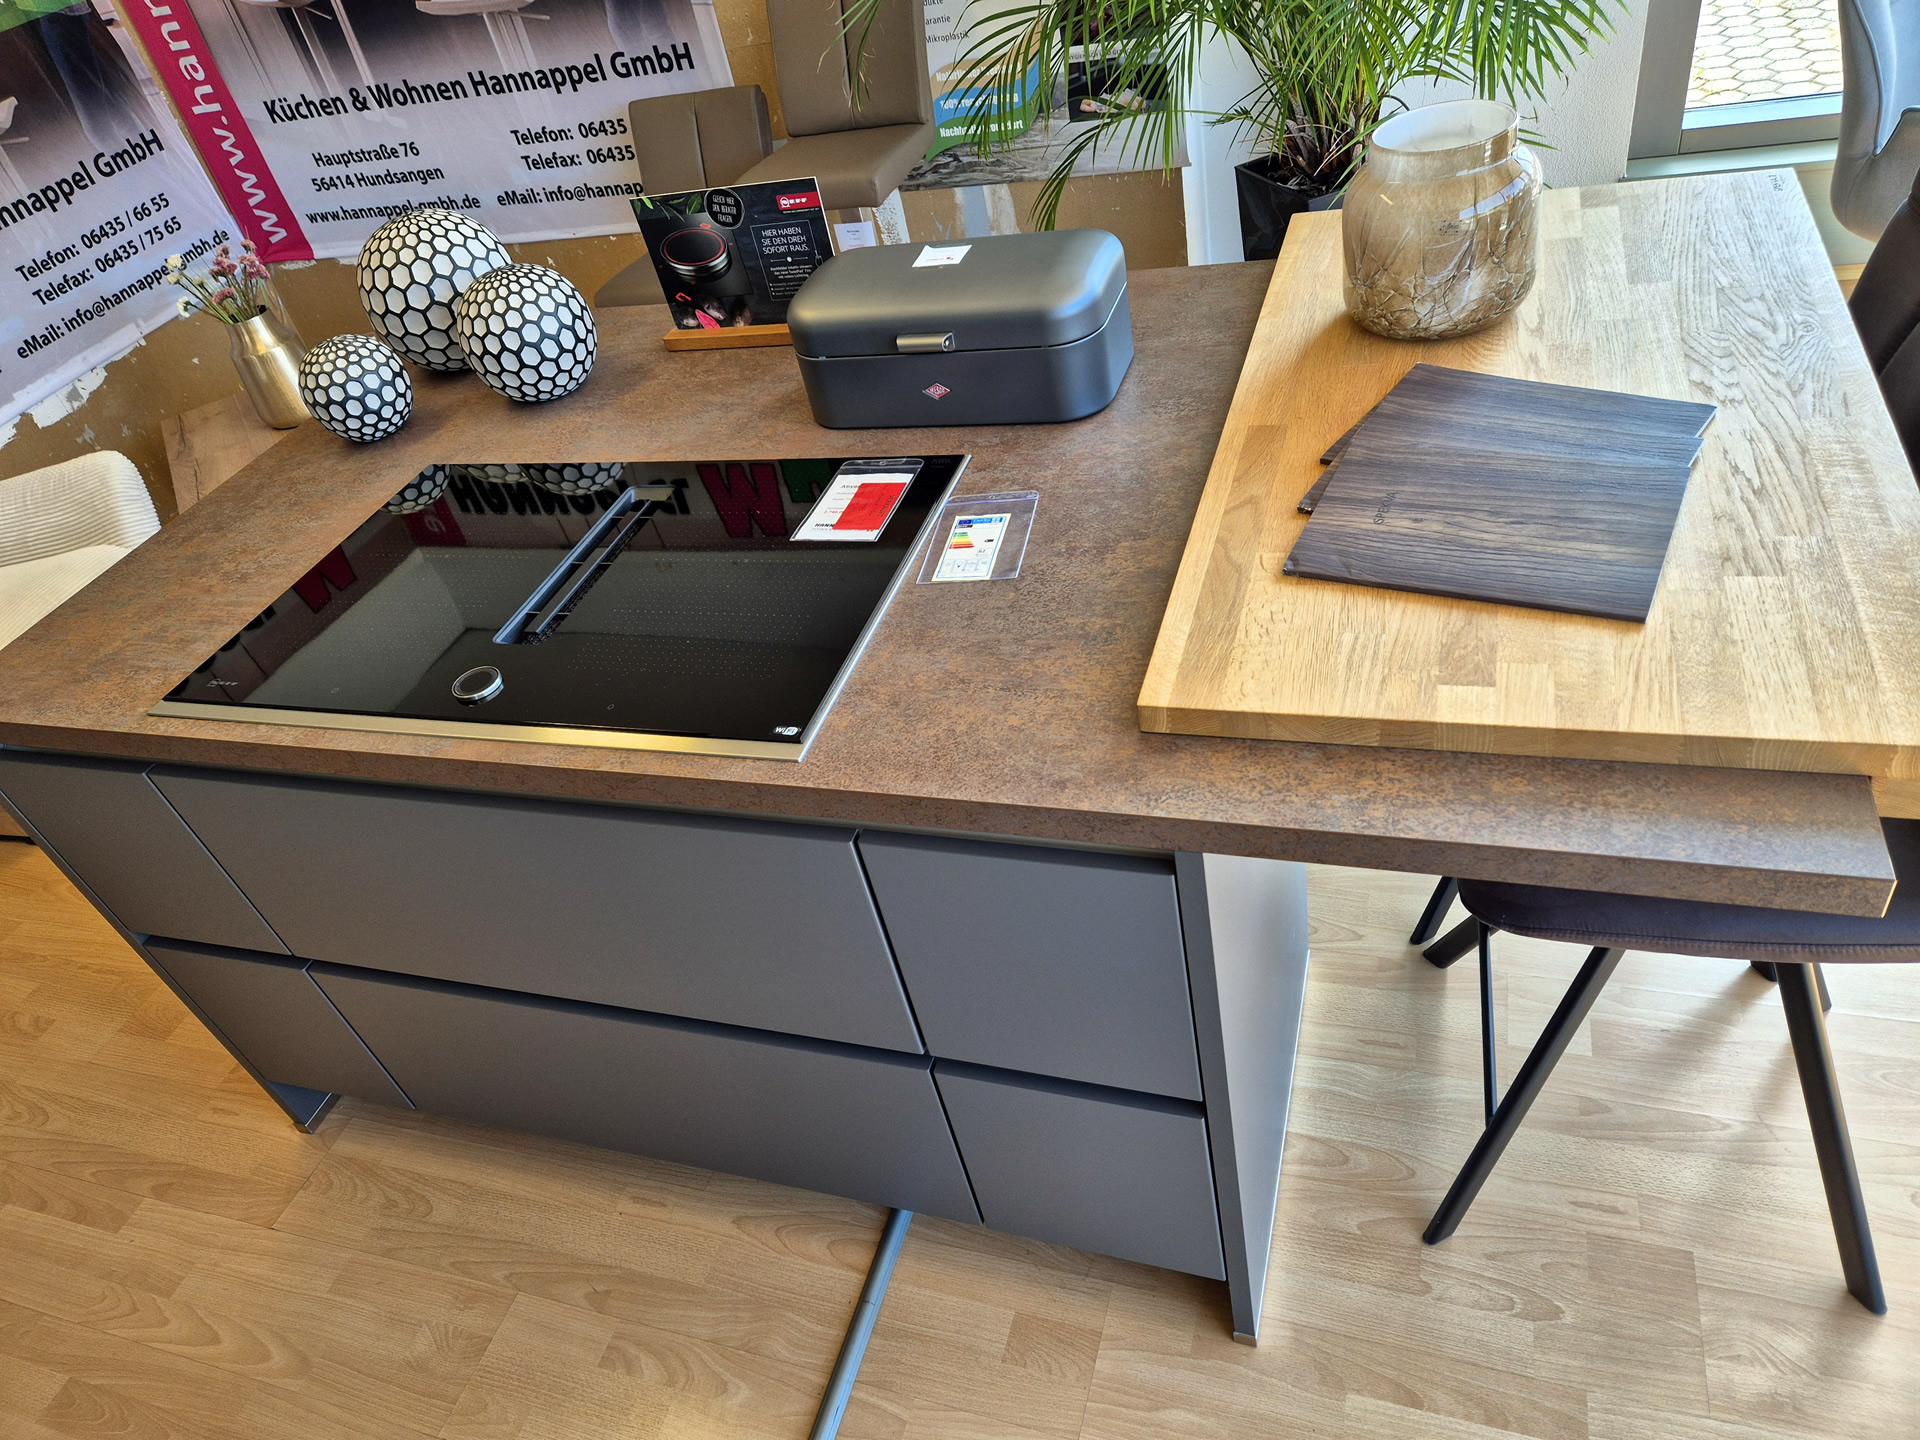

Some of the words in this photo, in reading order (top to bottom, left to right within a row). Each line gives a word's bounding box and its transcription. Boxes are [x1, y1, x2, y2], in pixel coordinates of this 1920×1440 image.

[262, 92, 348, 125] Küchen
[349, 86, 371, 112] &
[367, 75, 469, 109] Wohnen
[467, 54, 607, 98] Hannappel
[609, 42, 696, 79] GmbH
[510, 125, 574, 147] Telefon:
[577, 118, 628, 139] 06435
[93, 128, 165, 178] GmbH
[311, 145, 401, 168] Hauptstraße
[398, 142, 420, 158] 76
[521, 152, 582, 172] Telefax:
[586, 145, 636, 165] 06435
[311, 175, 355, 192] 56414
[354, 165, 445, 189] Hundsangen
[496, 185, 543, 207] eMail:
[15, 242, 80, 283] Telefon:
[81, 216, 126, 249] 06435
[125, 210, 133, 227] /
[133, 202, 151, 222] 66
[150, 193, 170, 212] 55
[761, 229, 779, 237] HIER
[779, 227, 802, 235] HABEN
[761, 238, 772, 246] SIE
[772, 237, 787, 245] DEN
[788, 235, 807, 243] DREH
[32, 269, 94, 306] Telefax:
[94, 240, 139, 273] 06435
[138, 234, 146, 250] /
[144, 225, 164, 246] 75
[163, 217, 182, 235] 65
[762, 246, 789, 254] SOFORT
[16, 322, 66, 359] eMail:
[61, 229, 230, 334] info@hannappegmbh.de
